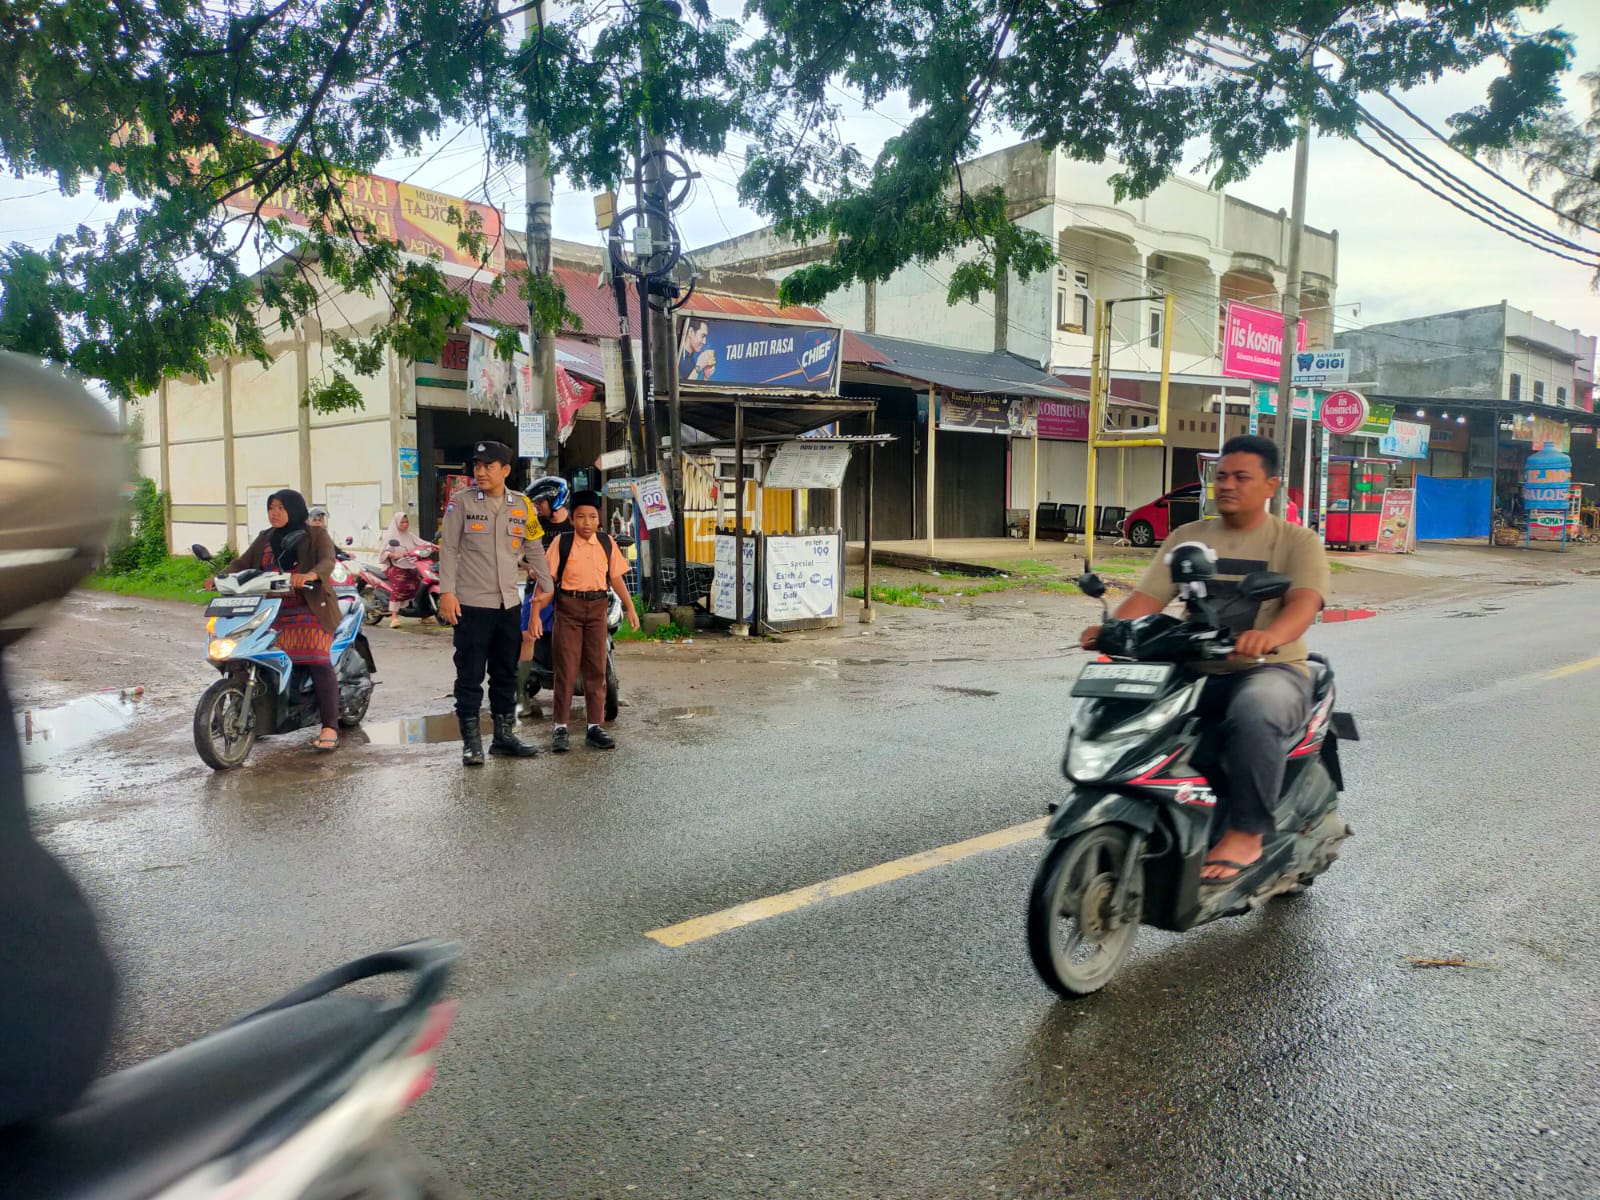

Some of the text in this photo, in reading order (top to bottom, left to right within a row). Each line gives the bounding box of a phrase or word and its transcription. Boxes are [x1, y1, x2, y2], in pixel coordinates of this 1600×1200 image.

[1231, 318, 1246, 347] iis
[726, 337, 794, 361] TAU ARTI RASA
[802, 340, 832, 368] CHIEF
[1316, 358, 1344, 369] GIGI
[1325, 403, 1359, 415] kosmetik
